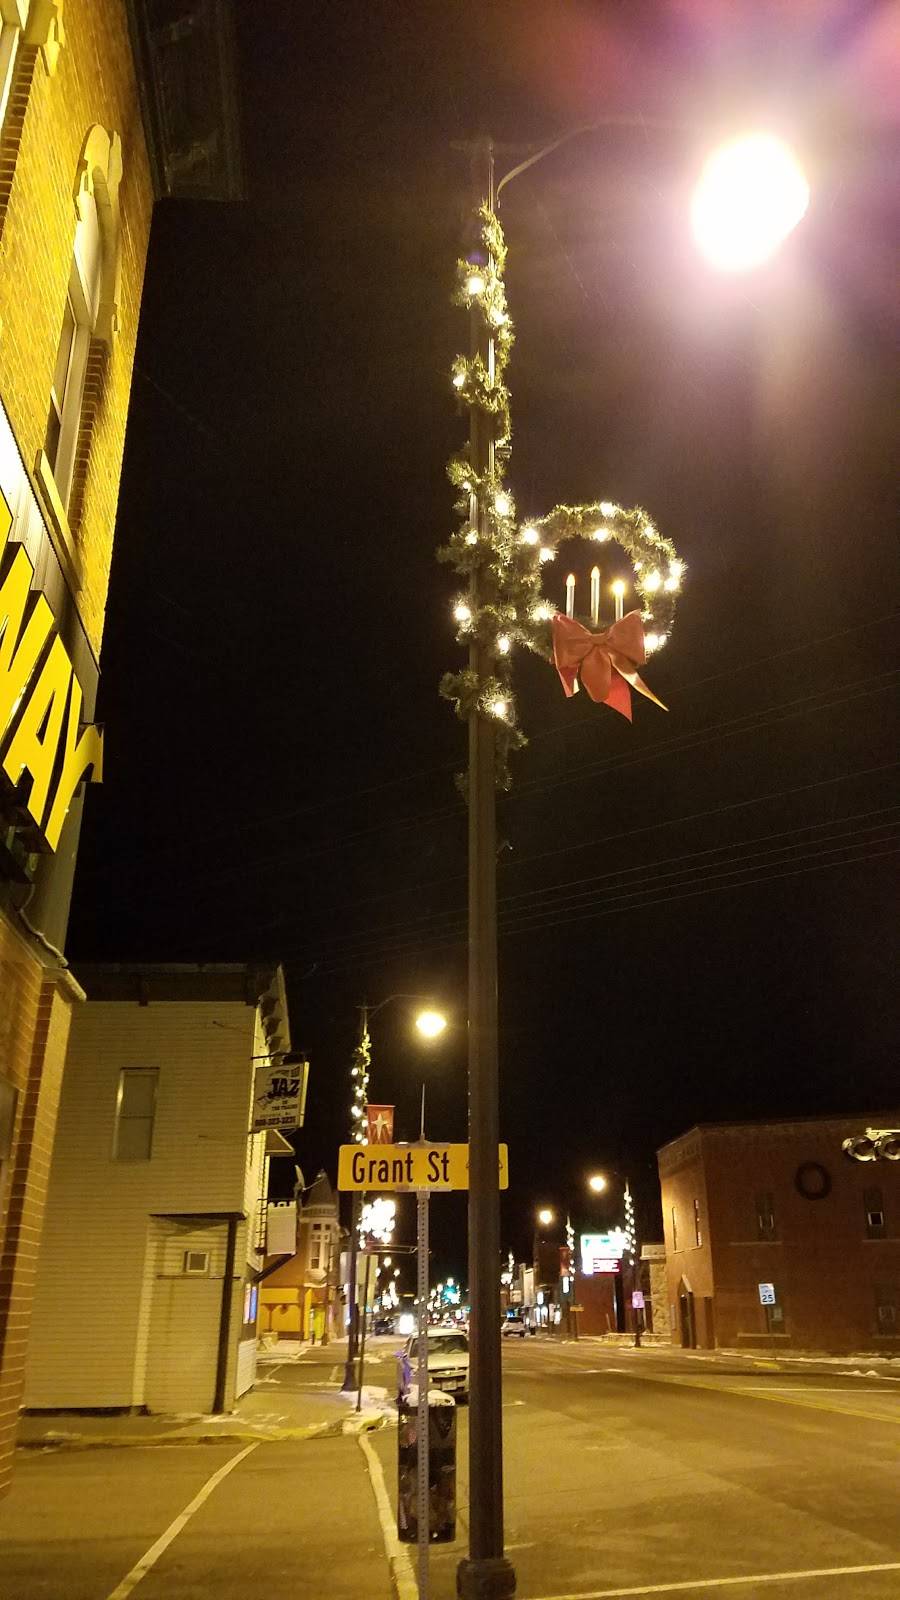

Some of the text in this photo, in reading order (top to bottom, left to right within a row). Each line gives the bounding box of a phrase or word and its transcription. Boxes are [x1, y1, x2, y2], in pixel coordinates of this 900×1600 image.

[352, 1150, 450, 1184] Grant St
[761, 1294, 774, 1303] 25
